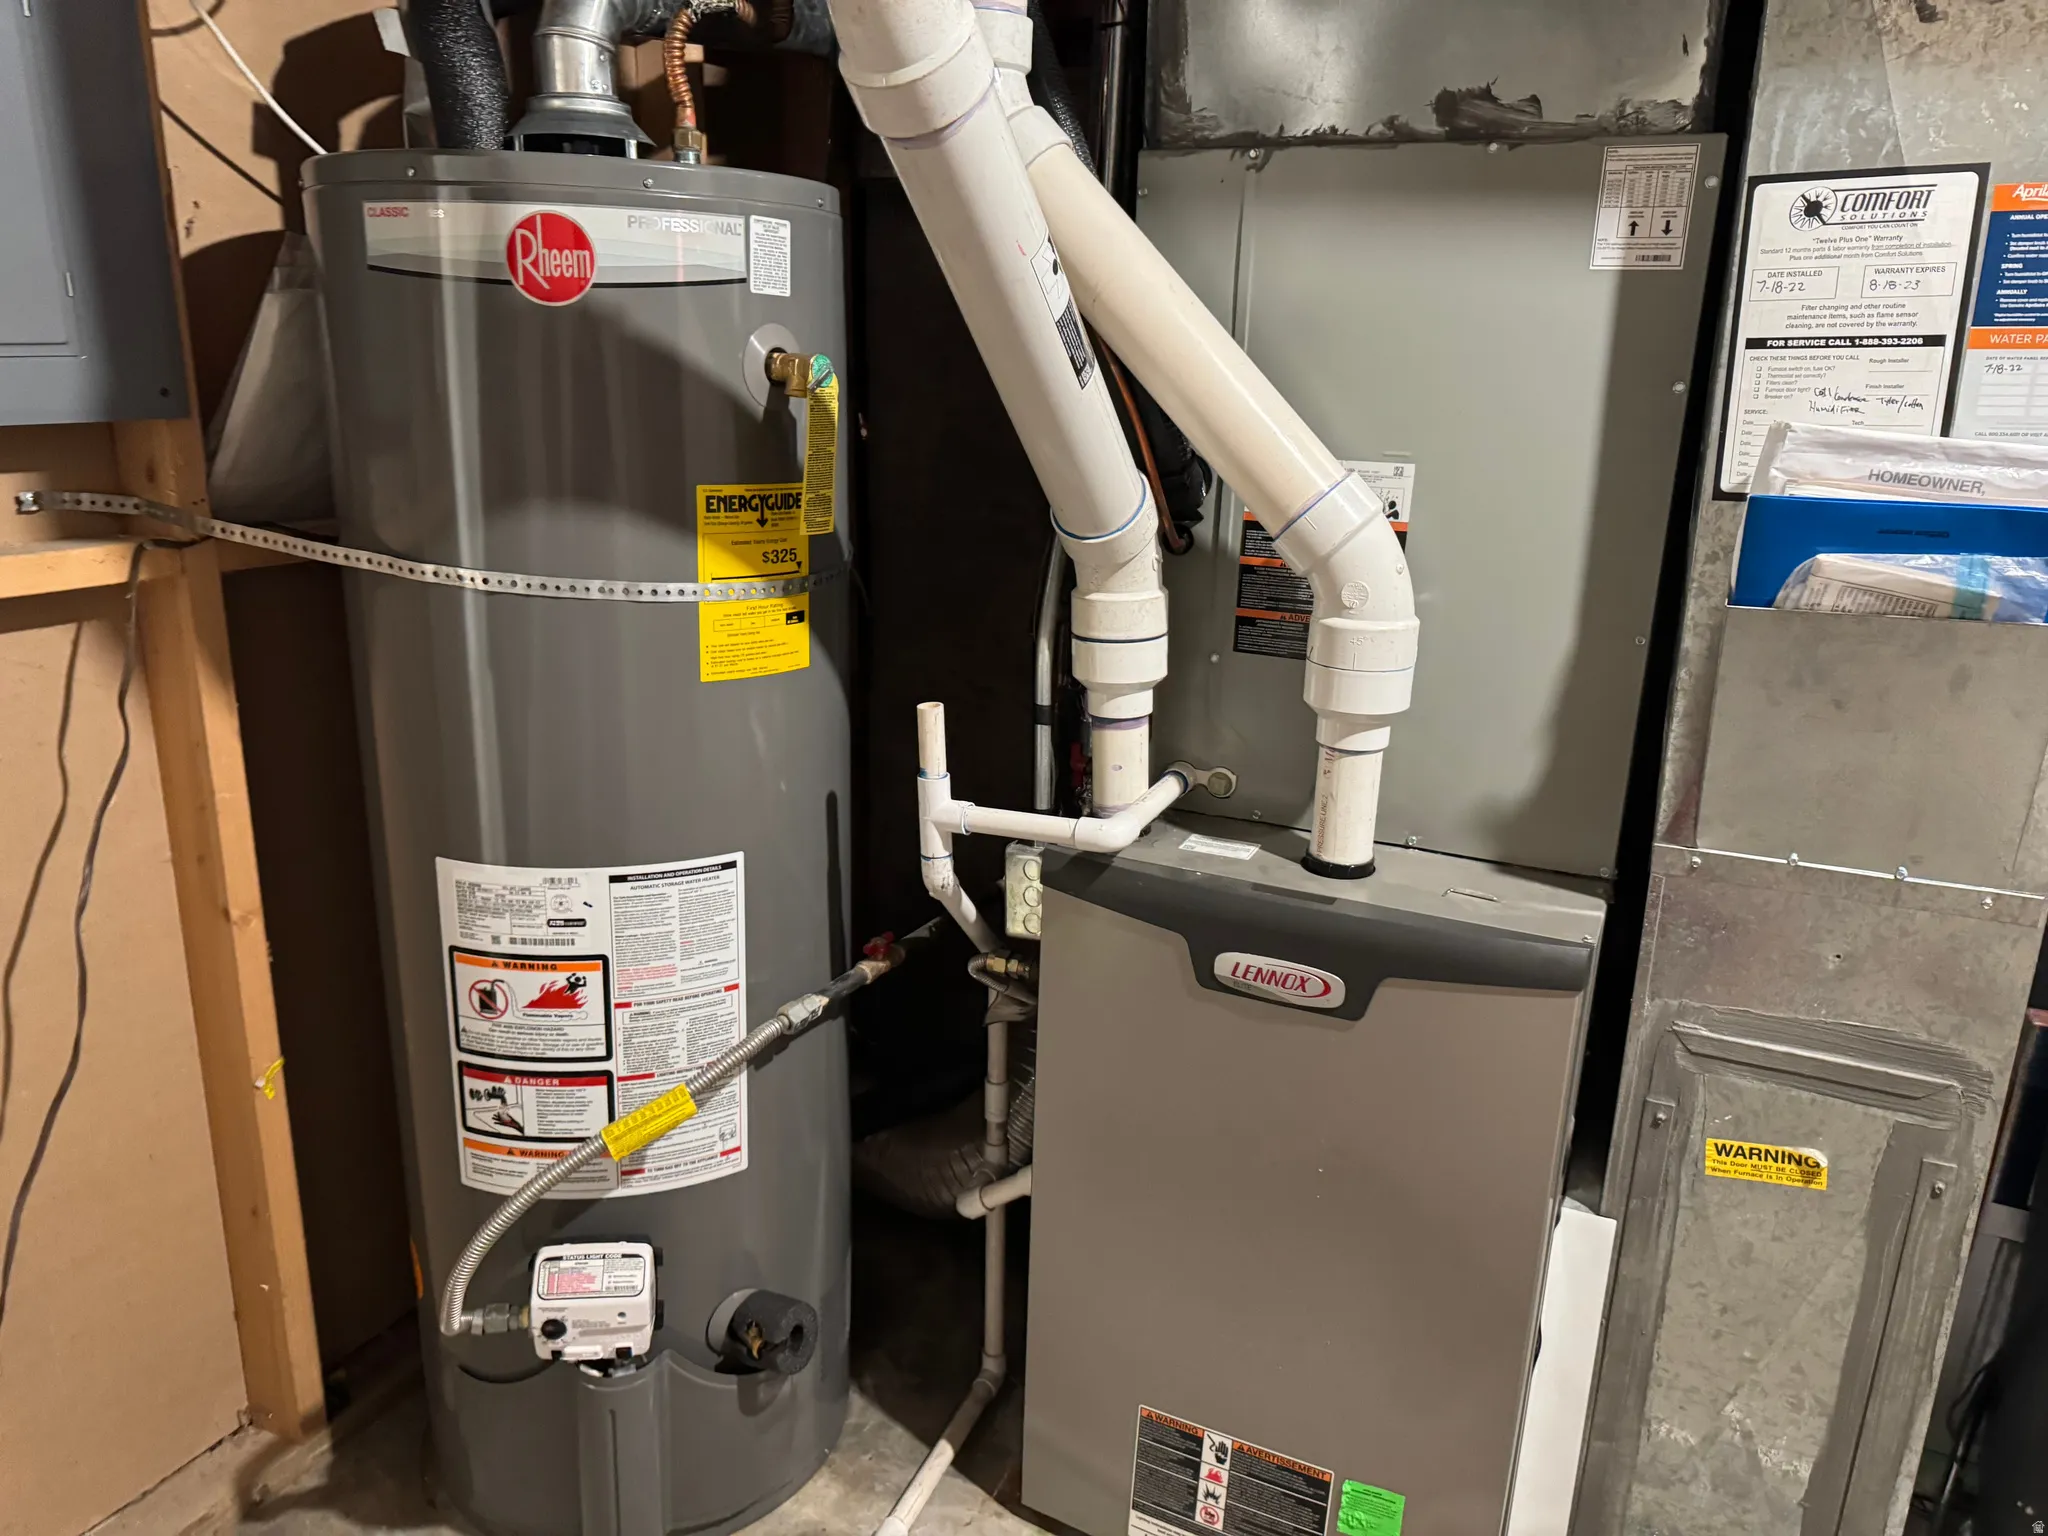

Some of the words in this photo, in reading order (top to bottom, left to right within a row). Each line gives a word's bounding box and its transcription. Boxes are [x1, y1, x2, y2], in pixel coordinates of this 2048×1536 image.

[1840, 189, 1935, 212] COMFORT
[367, 207, 409, 218] CLASSIC
[1840, 211, 1927, 221] SOLUTIONS
[627, 215, 742, 236] PROFESSIONAL
[515, 214, 591, 290] Rheem
[1786, 270, 1823, 278] INSTALLED
[1916, 266, 1946, 274] EXPIRES
[1756, 280, 1806, 294] 7-18-22
[1819, 304, 1848, 312] changing
[1828, 312, 1848, 320] items,
[1786, 322, 1814, 330] cleaning,
[1888, 320, 1918, 328] warranty.
[1787, 338, 1826, 346] SERVICE
[1828, 338, 1852, 346] CALL
[1990, 334, 2032, 344] WATER
[1984, 364, 2023, 374] 7-18-22
[1868, 469, 1986, 496] HOMEOWNER,
[762, 548, 798, 564] $325
[626, 872, 662, 881] INSTALLATION
[676, 868, 702, 878] OPERATION
[703, 864, 722, 873] DETAILS
[685, 878, 702, 886] WATER
[504, 961, 558, 970] WARNING
[1231, 962, 1311, 993] LENNOX
[656, 998, 672, 1006] SAFETY
[684, 993, 700, 1001] BEFORE
[514, 1077, 560, 1086] DANGER
[520, 1150, 565, 1158] WARNING
[1714, 1142, 1820, 1169] WARNING
[1730, 1160, 1748, 1168] Door
[1789, 1168, 1822, 1177] CLOSED
[1710, 1166, 1731, 1174] When
[1734, 1170, 1763, 1178] Furnace
[1786, 1176, 1823, 1186] Operation
[1154, 1412, 1199, 1435] WARNING
[1246, 1446, 1327, 1480] AVERTISSEMENT
